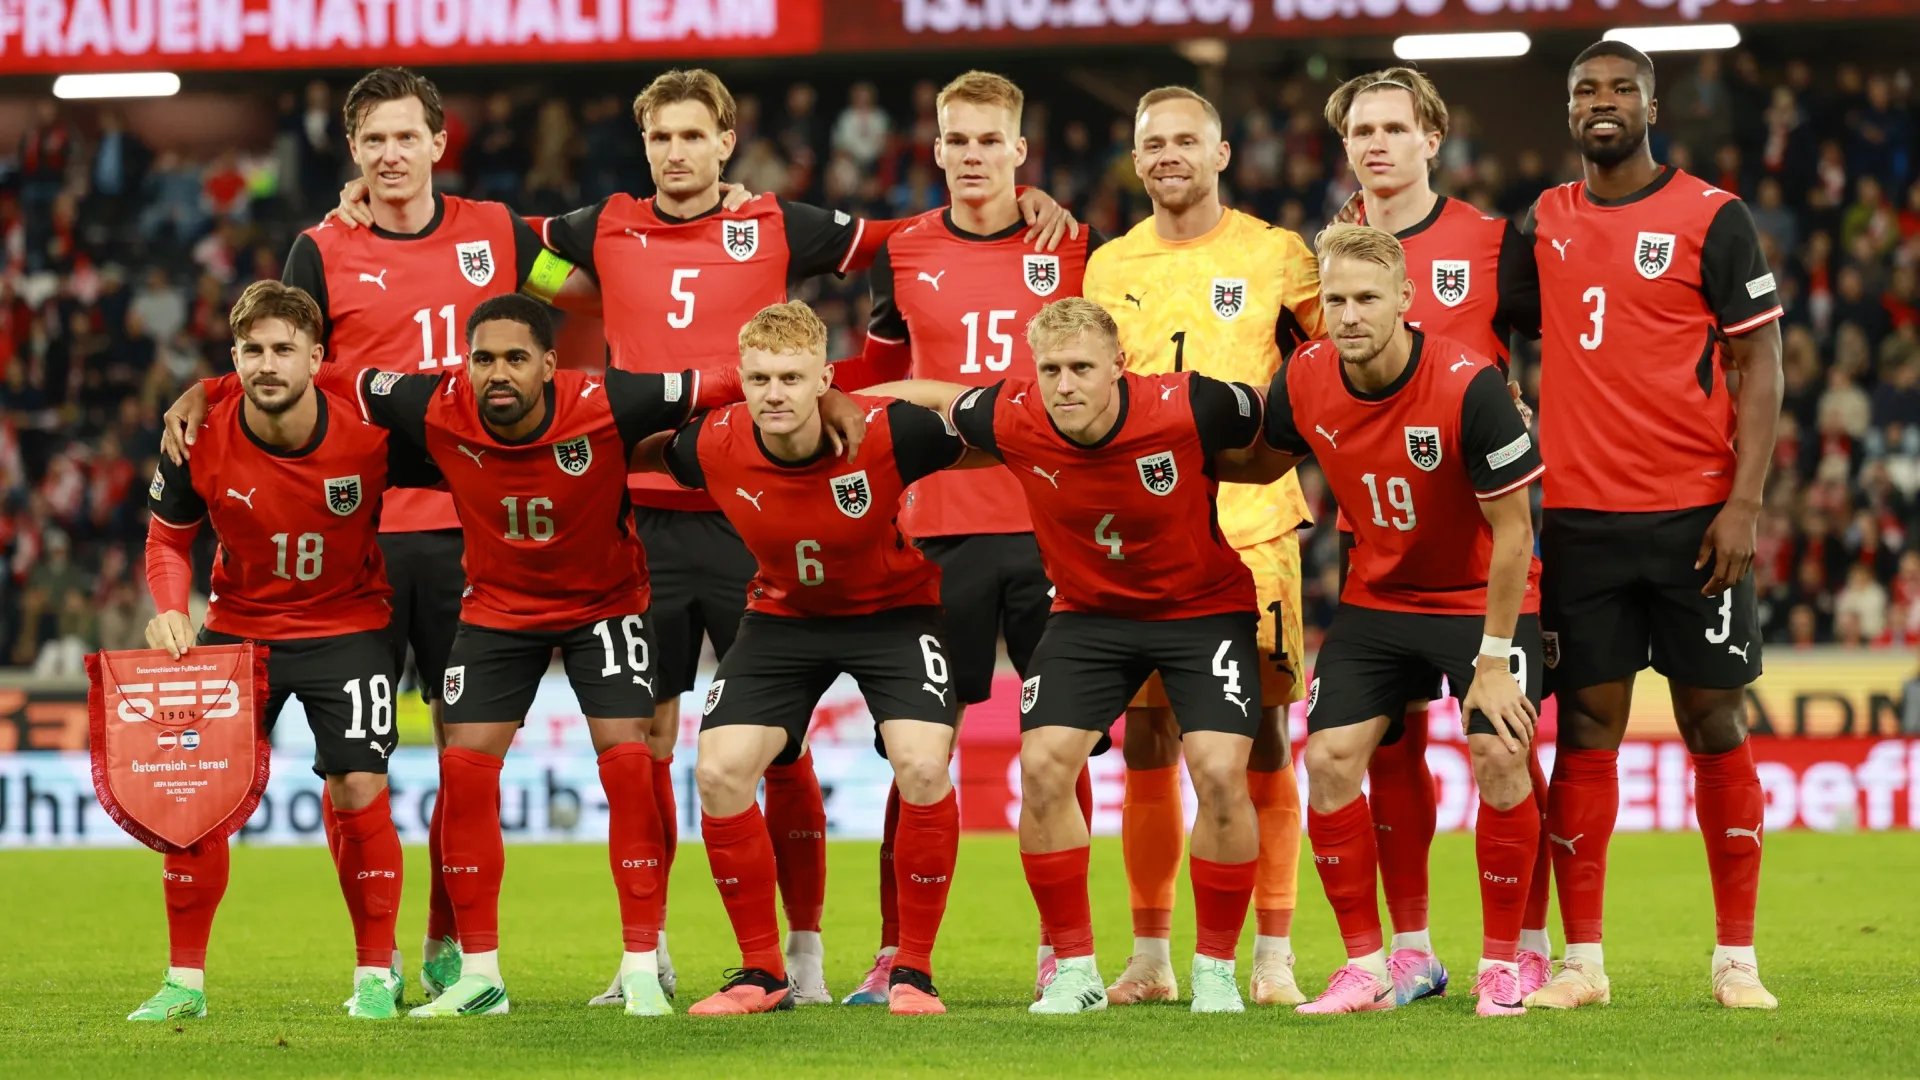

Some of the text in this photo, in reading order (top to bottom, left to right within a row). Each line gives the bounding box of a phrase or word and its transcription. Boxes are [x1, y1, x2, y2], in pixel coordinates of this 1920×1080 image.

[666, 269, 701, 329] 5
[1579, 286, 1606, 350] 3
[413, 304, 462, 370] 11
[959, 310, 1017, 373] 15
[1170, 331, 1186, 372] 1
[500, 496, 554, 541] 16
[1361, 473, 1417, 531] 19
[270, 532, 324, 581] 18
[1094, 513, 1125, 560] 4
[795, 540, 824, 586] 6
[1266, 600, 1288, 661] 1
[1704, 587, 1731, 643] 3
[592, 614, 649, 677] 16
[918, 634, 948, 684] 6
[1211, 640, 1241, 693] 4
[159, 710, 196, 721] 1904
[342, 674, 392, 738] 18
[132, 759, 187, 773] Österreich
[198, 758, 228, 770] Israel
[0, 771, 98, 836] hr
[788, 830, 822, 839] ÖFB
[357, 870, 395, 880] ÖFB
[442, 865, 478, 873] ÖFB
[622, 858, 658, 868] ÖFB
[713, 877, 739, 885] FB
[910, 873, 946, 883] ÖFB
[1483, 870, 1518, 884] ÖFB
